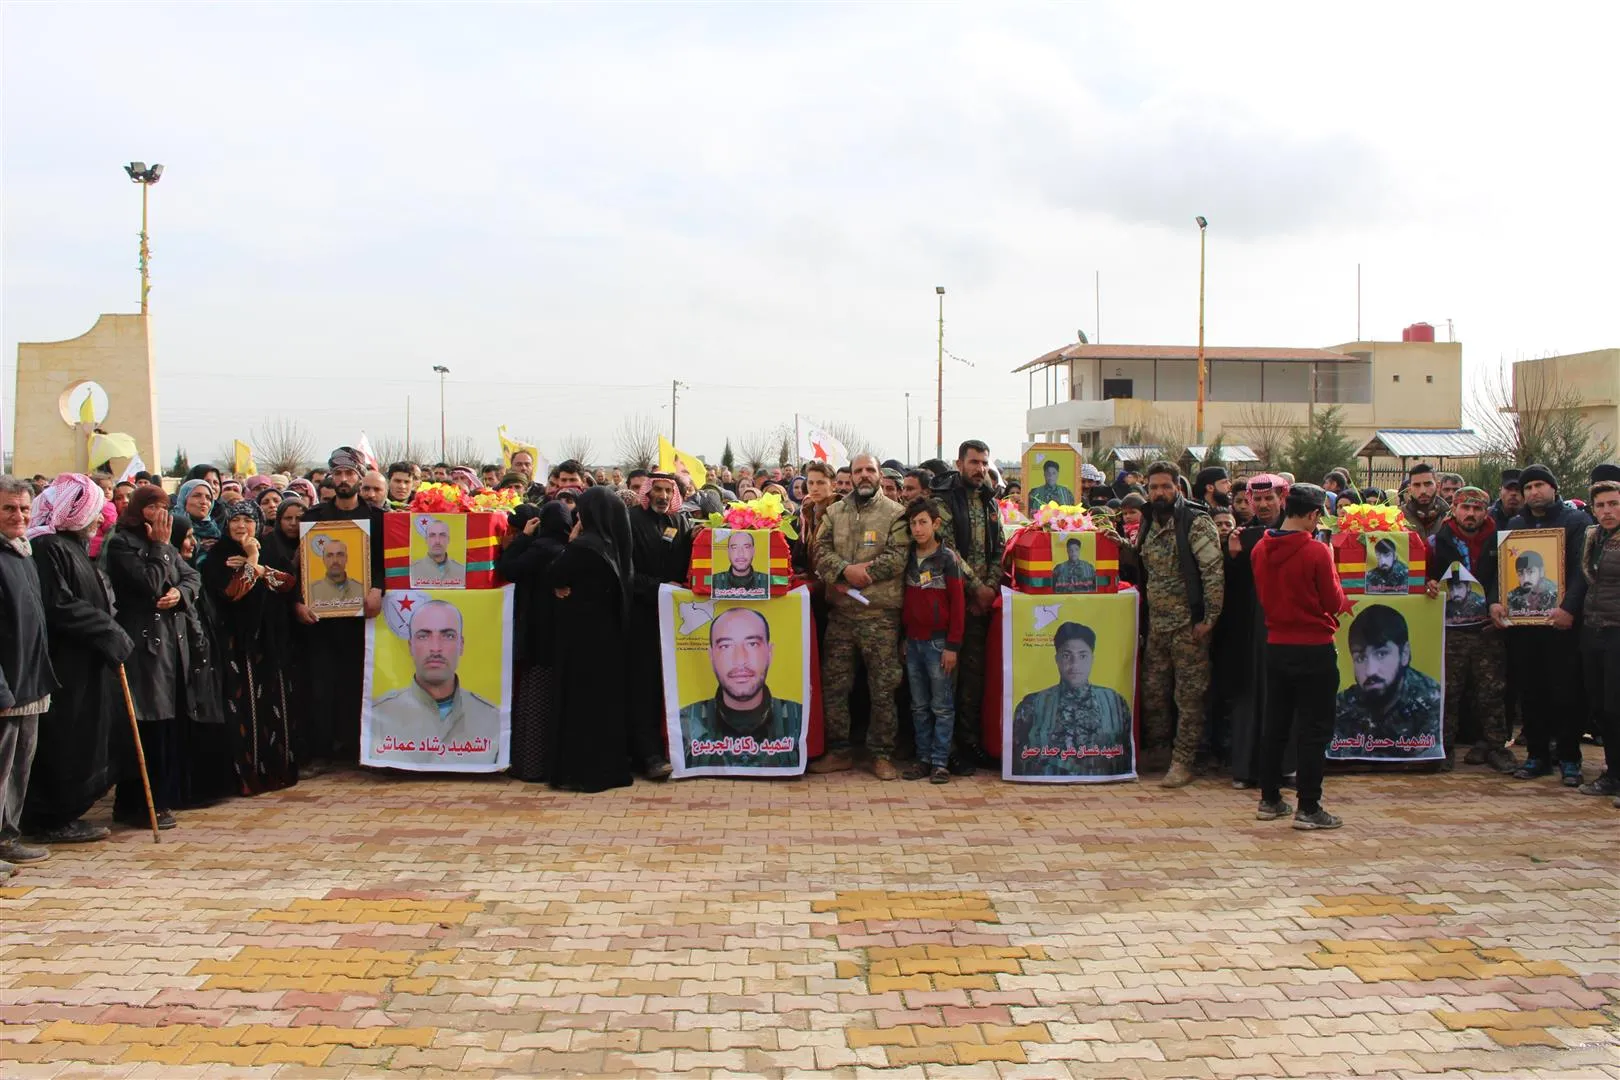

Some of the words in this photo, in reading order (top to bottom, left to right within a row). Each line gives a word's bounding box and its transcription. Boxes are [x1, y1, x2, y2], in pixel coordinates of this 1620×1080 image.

[376, 735, 416, 754] عماش
[419, 736, 446, 756] رشاد
[448, 737, 491, 756] الشهيد
[732, 736, 760, 755] راكان
[760, 736, 794, 756] الشهيد
[1330, 733, 1365, 751] الحسن
[1365, 734, 1395, 751] حسن
[1395, 732, 1436, 752] الشهيد
